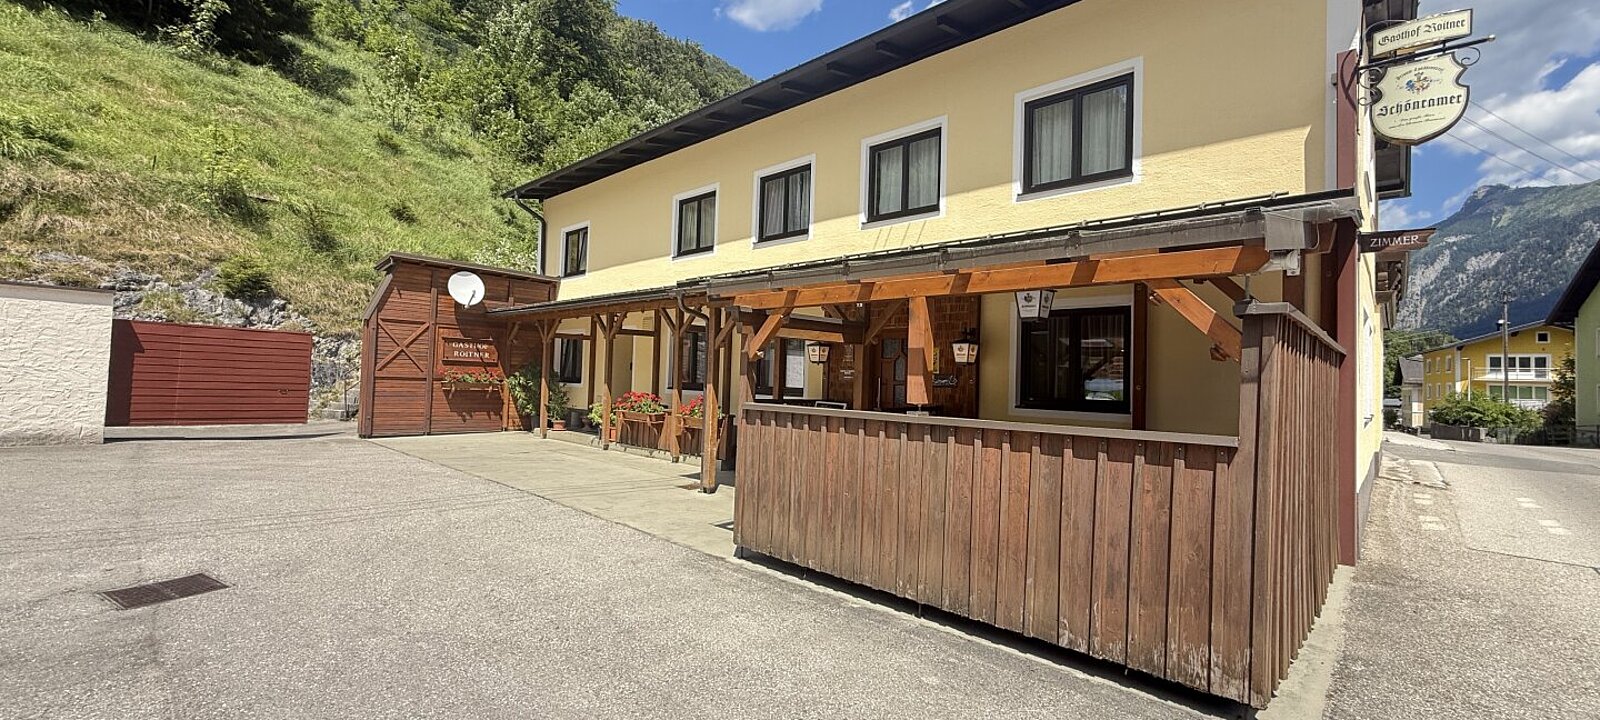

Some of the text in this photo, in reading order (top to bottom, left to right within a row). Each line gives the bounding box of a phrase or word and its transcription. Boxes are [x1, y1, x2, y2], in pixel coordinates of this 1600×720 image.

[1378, 18, 1466, 46] Gasthof Roitner
[1377, 94, 1462, 116] Schönramer
[1370, 235, 1421, 247] ZIMMER
